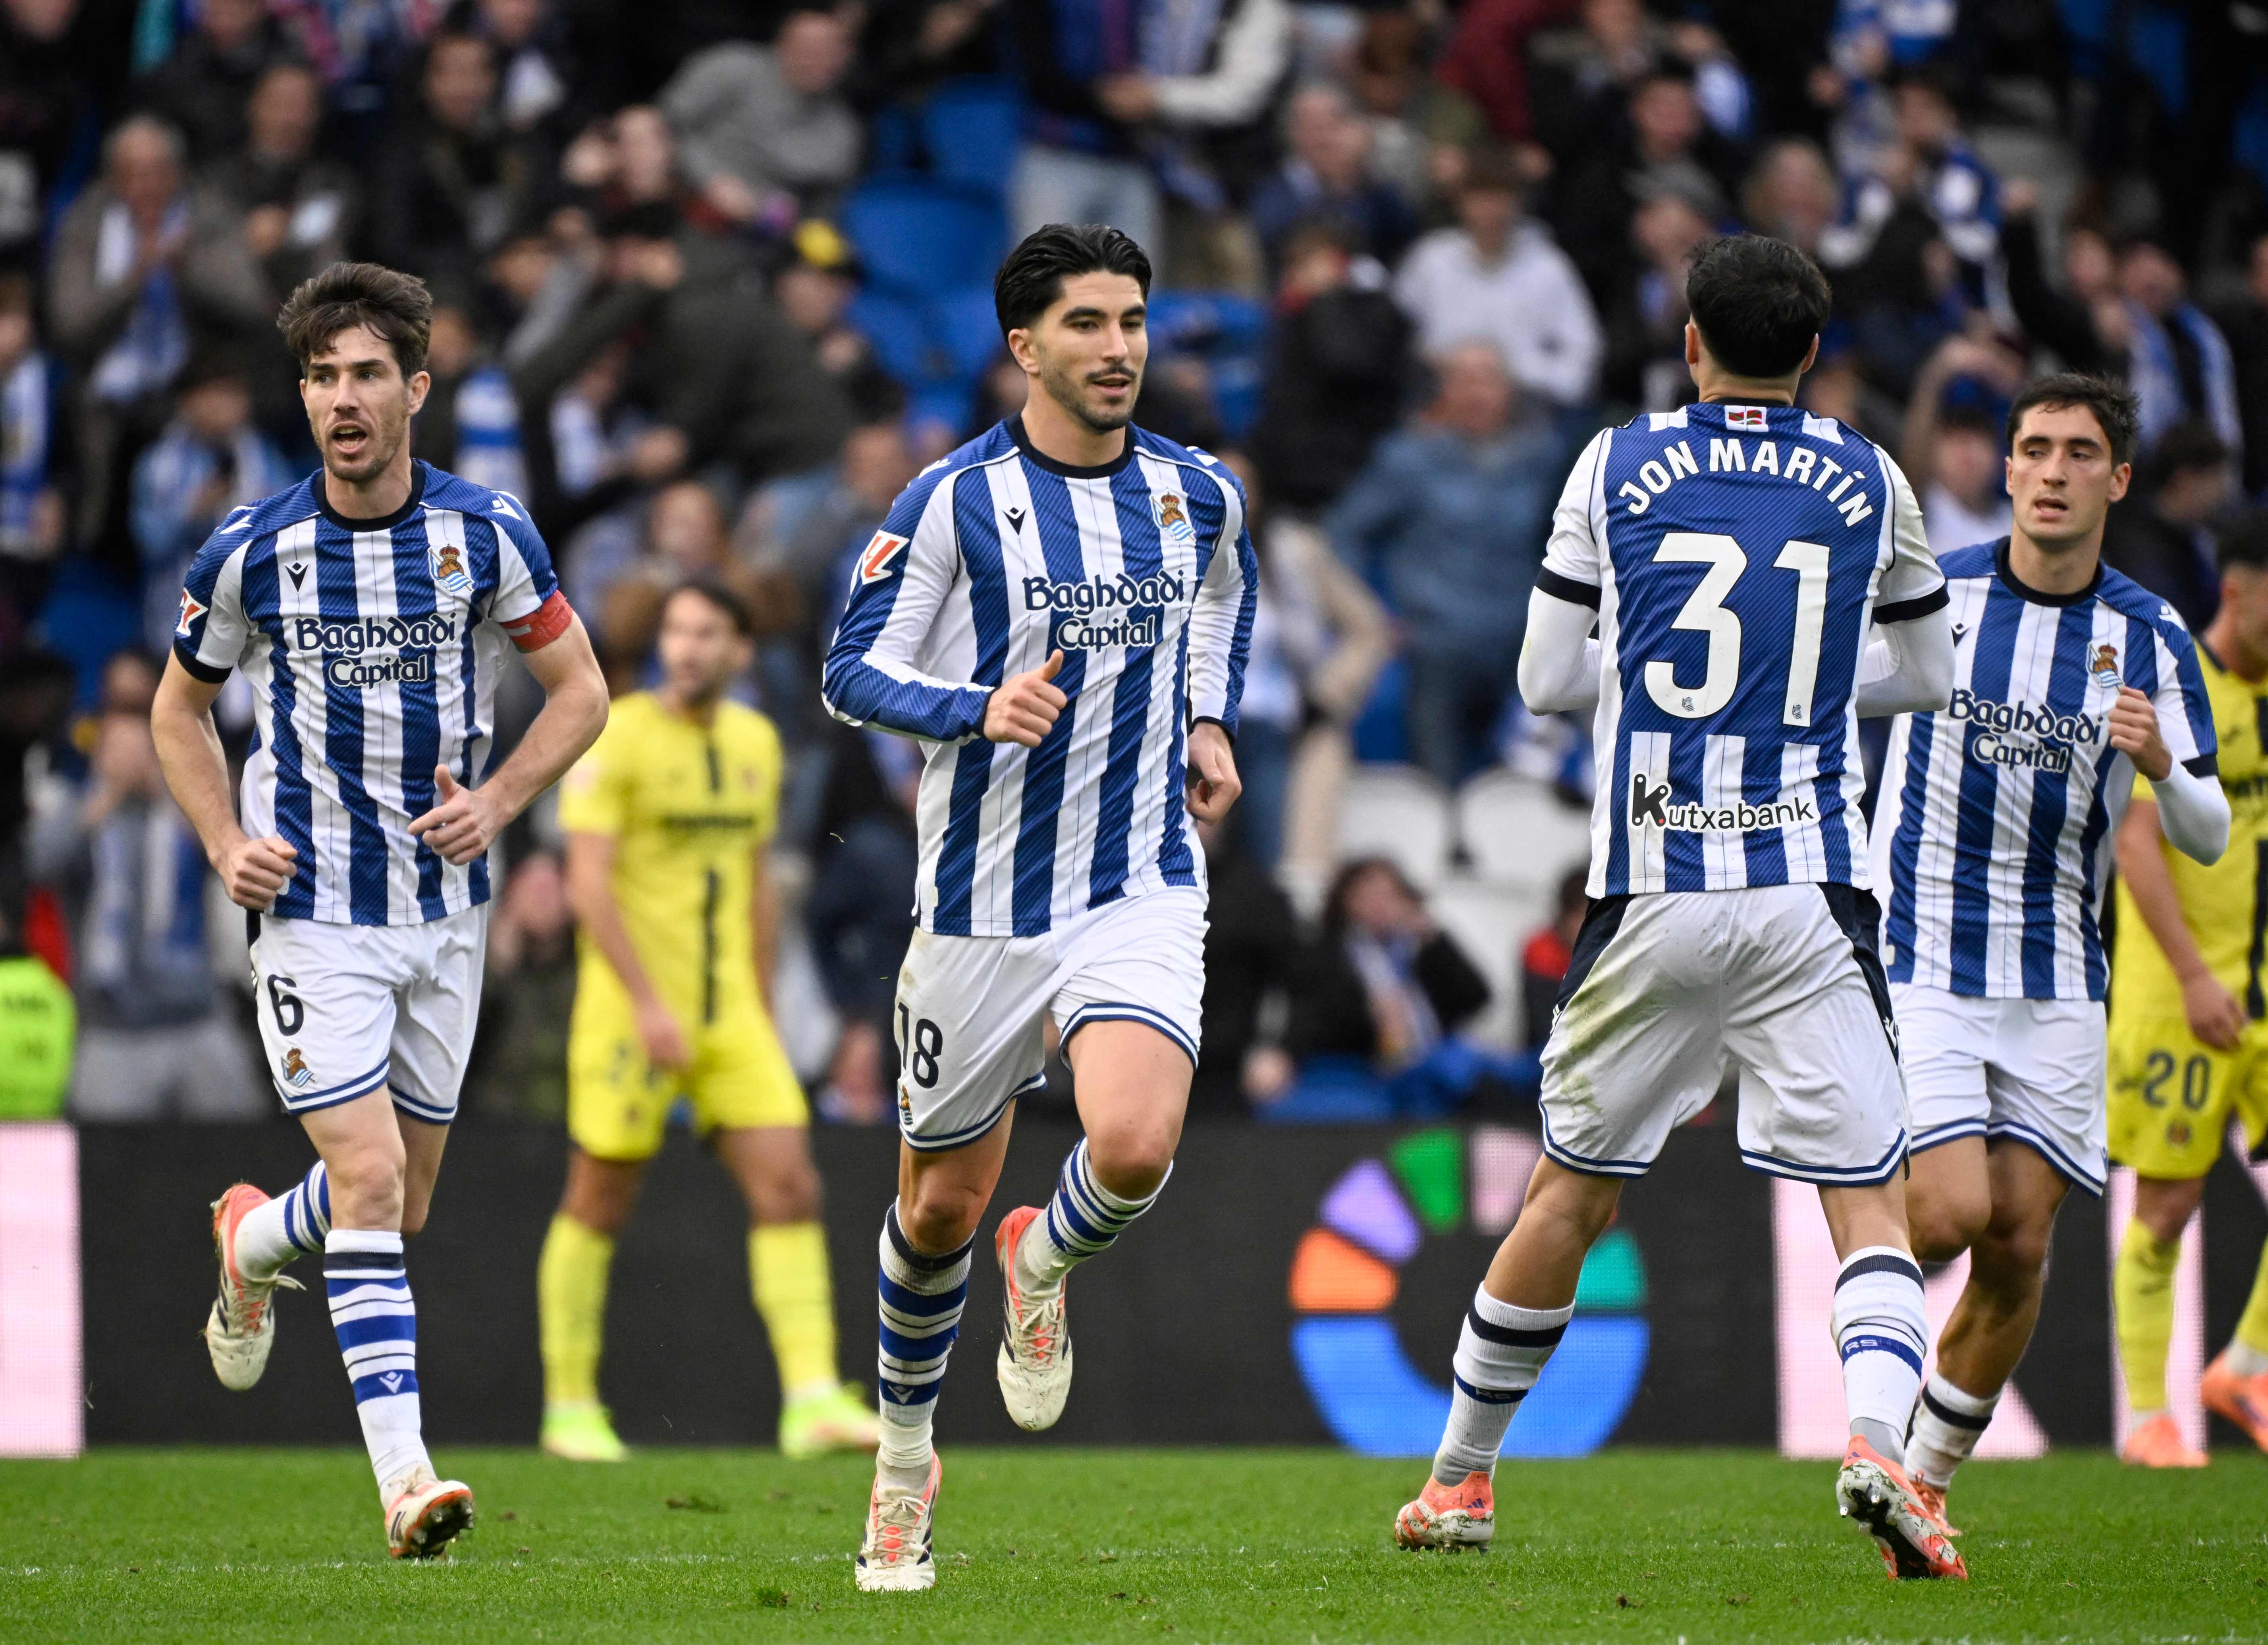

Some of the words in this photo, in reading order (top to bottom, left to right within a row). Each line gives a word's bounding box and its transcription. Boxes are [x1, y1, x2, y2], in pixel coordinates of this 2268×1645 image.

[1618, 441, 1700, 514] JON
[1709, 439, 1873, 527] MARTÍN
[1022, 569, 1184, 616] Baghdadi
[295, 612, 457, 656] Baghdadi
[1058, 616, 1154, 654] Capital
[1644, 532, 1830, 727] 31
[330, 655, 426, 690] Capital
[1949, 688, 2104, 745] Baghdadi
[1974, 735, 2069, 772] Capital
[1632, 773, 1815, 830] Kutxabank
[267, 974, 304, 1036] 6
[897, 1001, 943, 1089] 18
[2144, 1048, 2211, 1110] 20
[1845, 1339, 1878, 1354] RS
